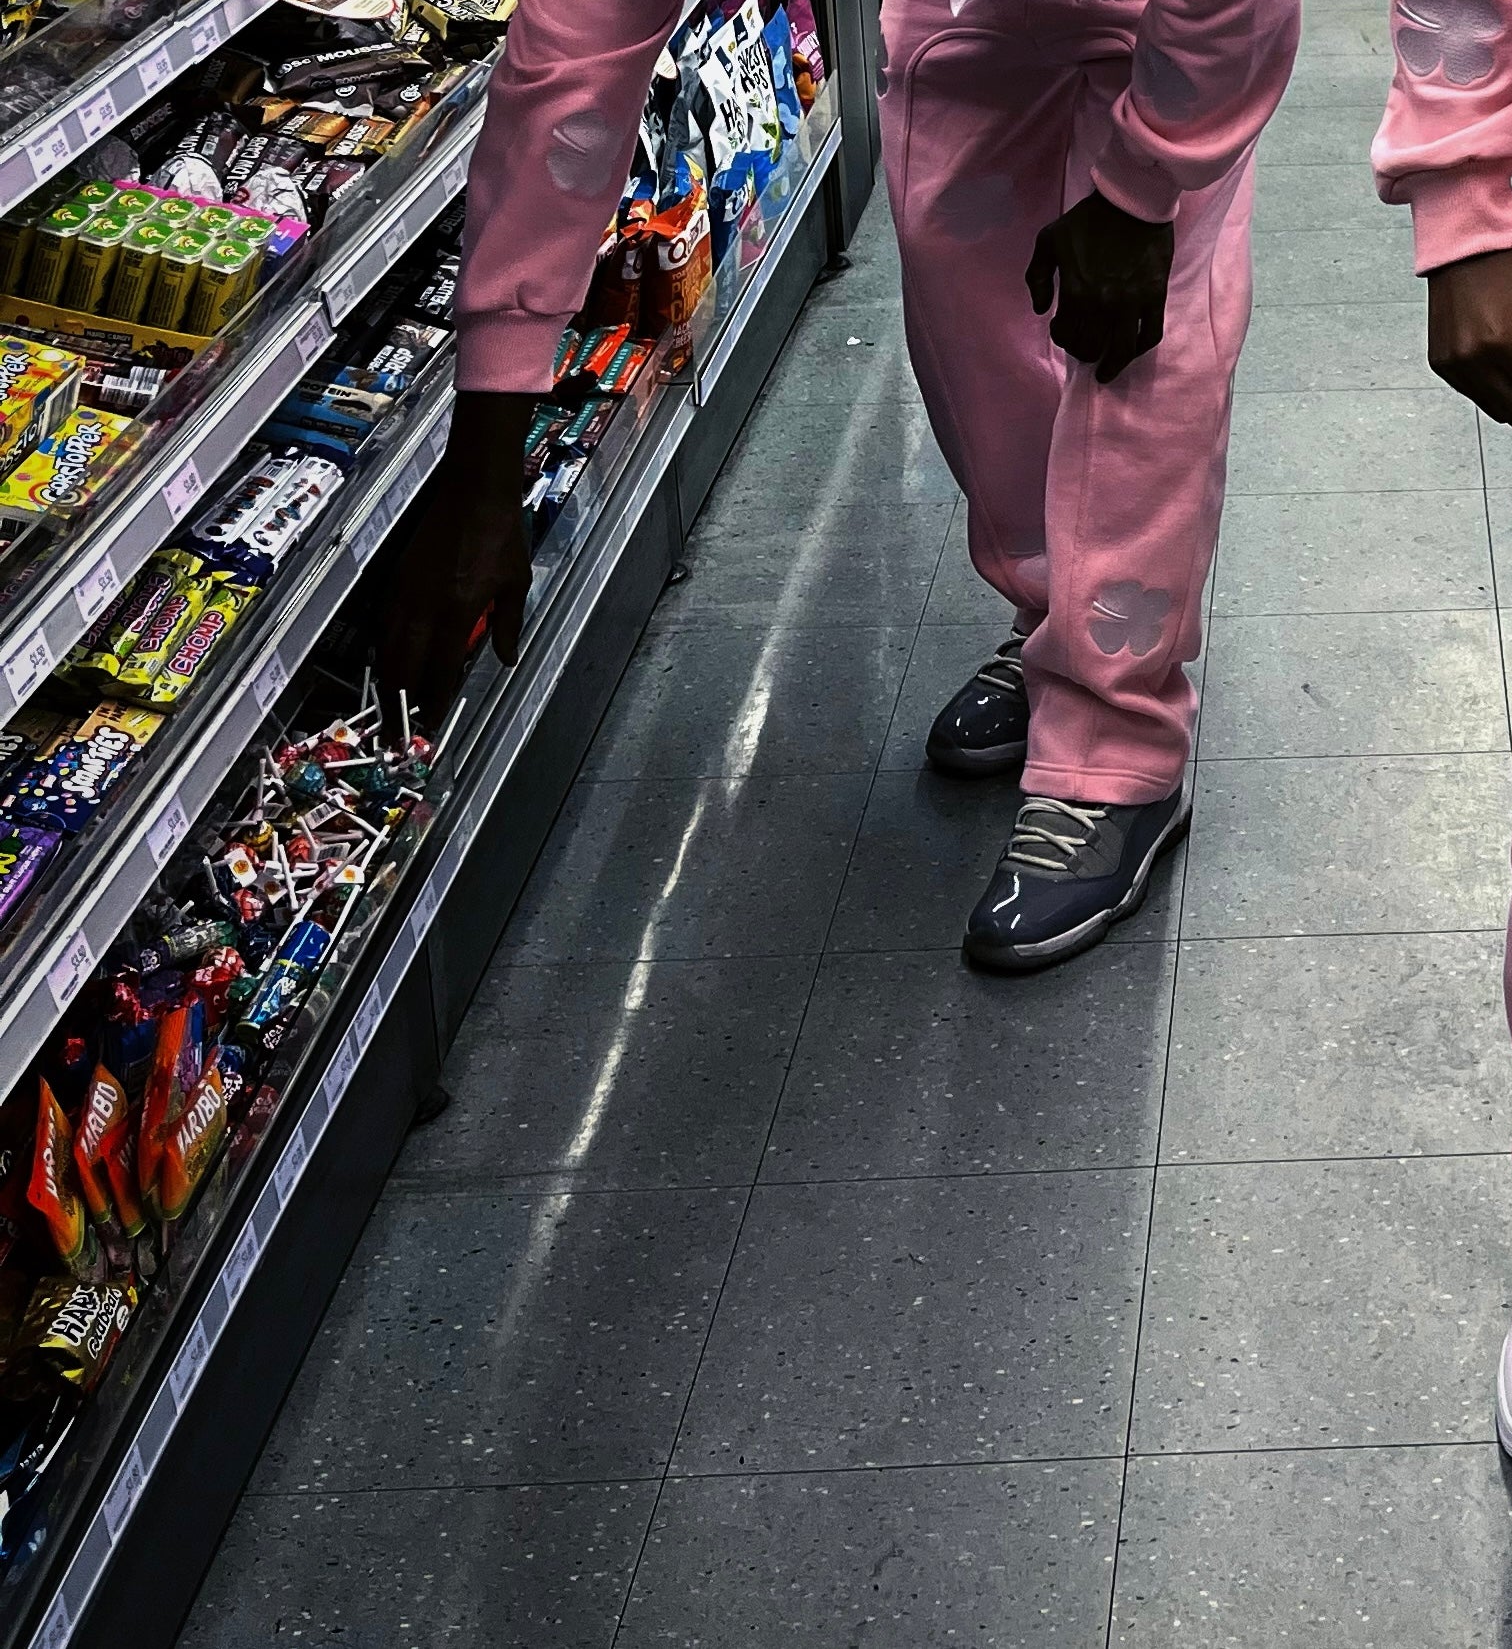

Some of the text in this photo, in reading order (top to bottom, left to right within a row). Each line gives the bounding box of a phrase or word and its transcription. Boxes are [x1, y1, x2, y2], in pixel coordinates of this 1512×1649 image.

[316, 41, 396, 63] MOUSSE
[226, 136, 269, 181] LOW CARB
[135, 594, 189, 654] CHOMP
[168, 610, 225, 677] CHOMP
